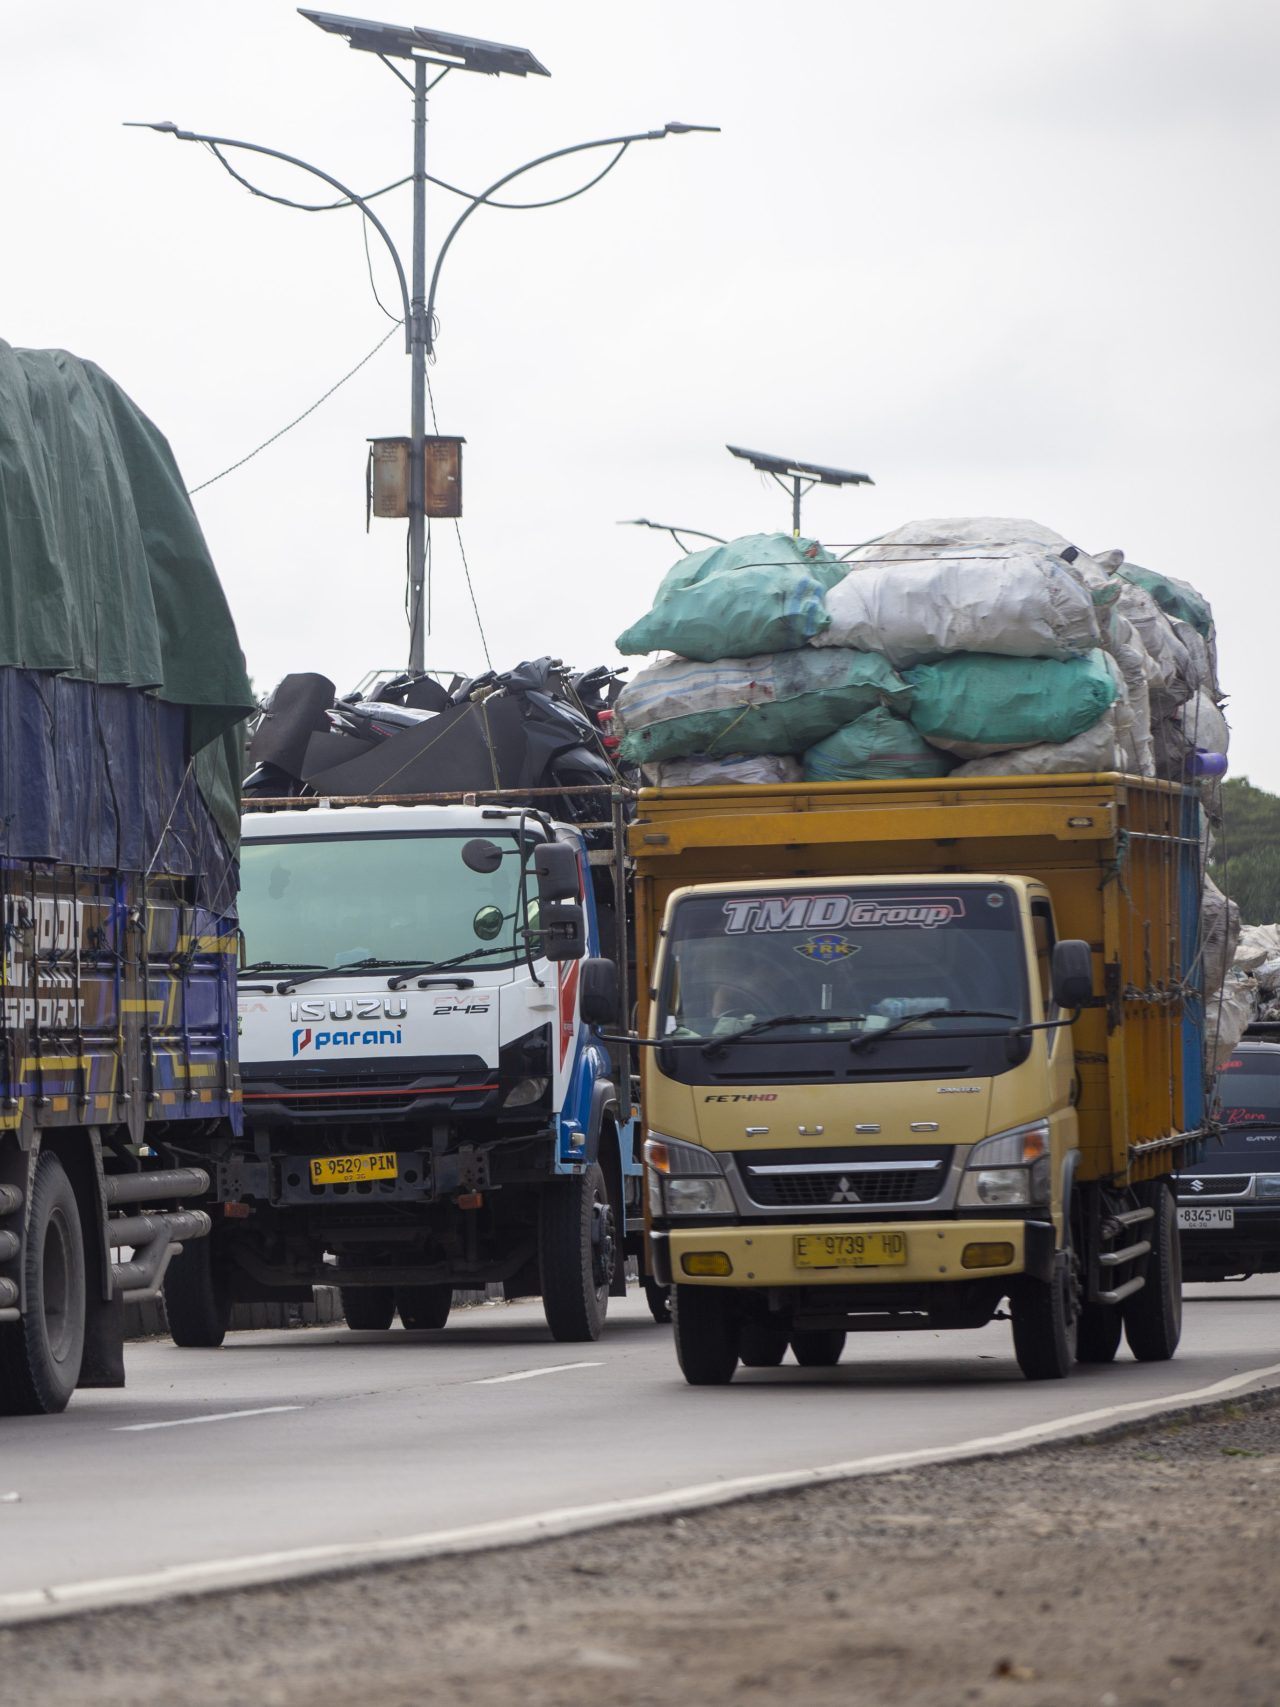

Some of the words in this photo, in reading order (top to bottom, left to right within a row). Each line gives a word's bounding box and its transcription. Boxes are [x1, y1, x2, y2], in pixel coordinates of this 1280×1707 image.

[723, 895, 852, 934] TMD
[849, 903, 954, 929] Group
[290, 998, 408, 1022] ISUZU
[432, 1004, 491, 1016] 245
[314, 1024, 402, 1050] parani
[745, 1121, 940, 1138] FUSO
[313, 1161, 322, 1176] B
[369, 1155, 395, 1171] PIN
[1184, 1209, 1212, 1222] 8345
[1218, 1209, 1232, 1221] VG
[797, 1237, 808, 1256] E
[825, 1235, 865, 1255] 9739
[882, 1234, 902, 1254] HD
